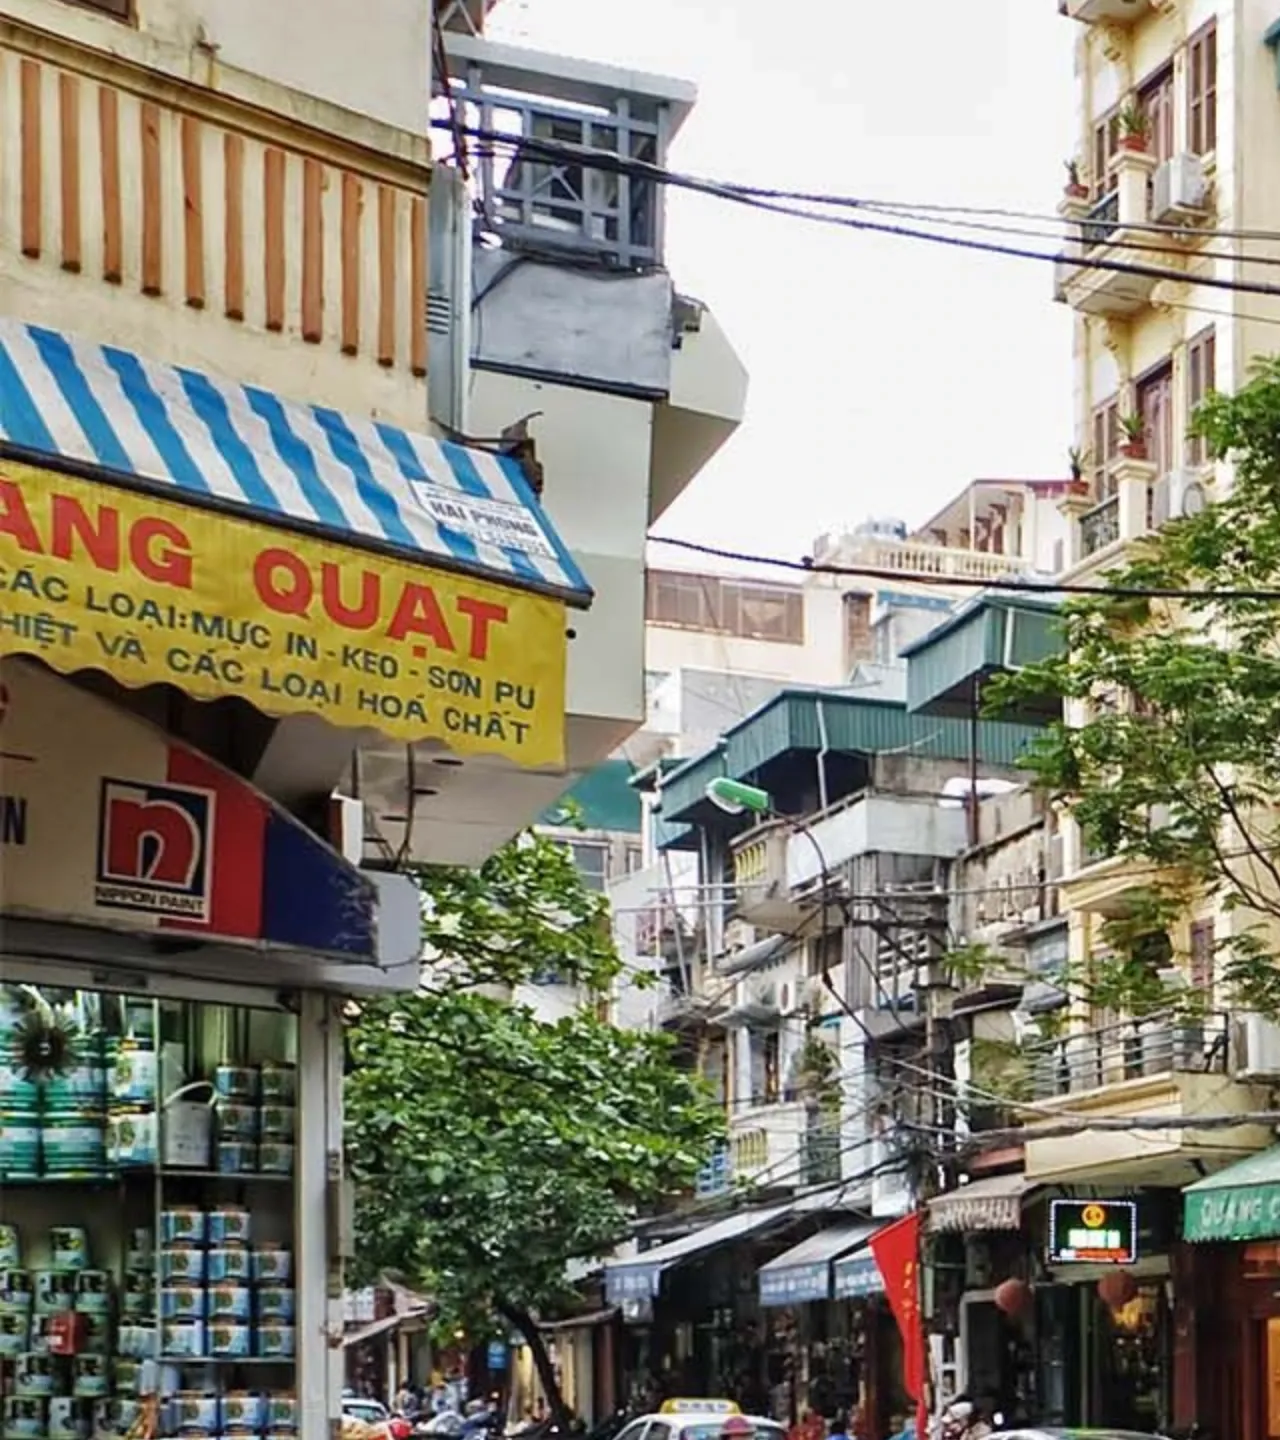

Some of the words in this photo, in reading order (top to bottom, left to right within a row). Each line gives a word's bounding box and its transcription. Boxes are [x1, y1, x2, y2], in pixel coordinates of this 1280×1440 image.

[252, 546, 509, 660] QUẠT
[96, 629, 147, 664] VÀ
[166, 648, 244, 685] CÁC
[260, 668, 342, 709] LOẠI
[357, 689, 429, 724] HOÁ
[443, 706, 531, 744] CHẤT
[286, 630, 318, 661] IN
[341, 645, 400, 680] KEO
[494, 680, 536, 710] PU
[97, 886, 155, 906] NIPPON
[159, 893, 206, 912] PAINT
